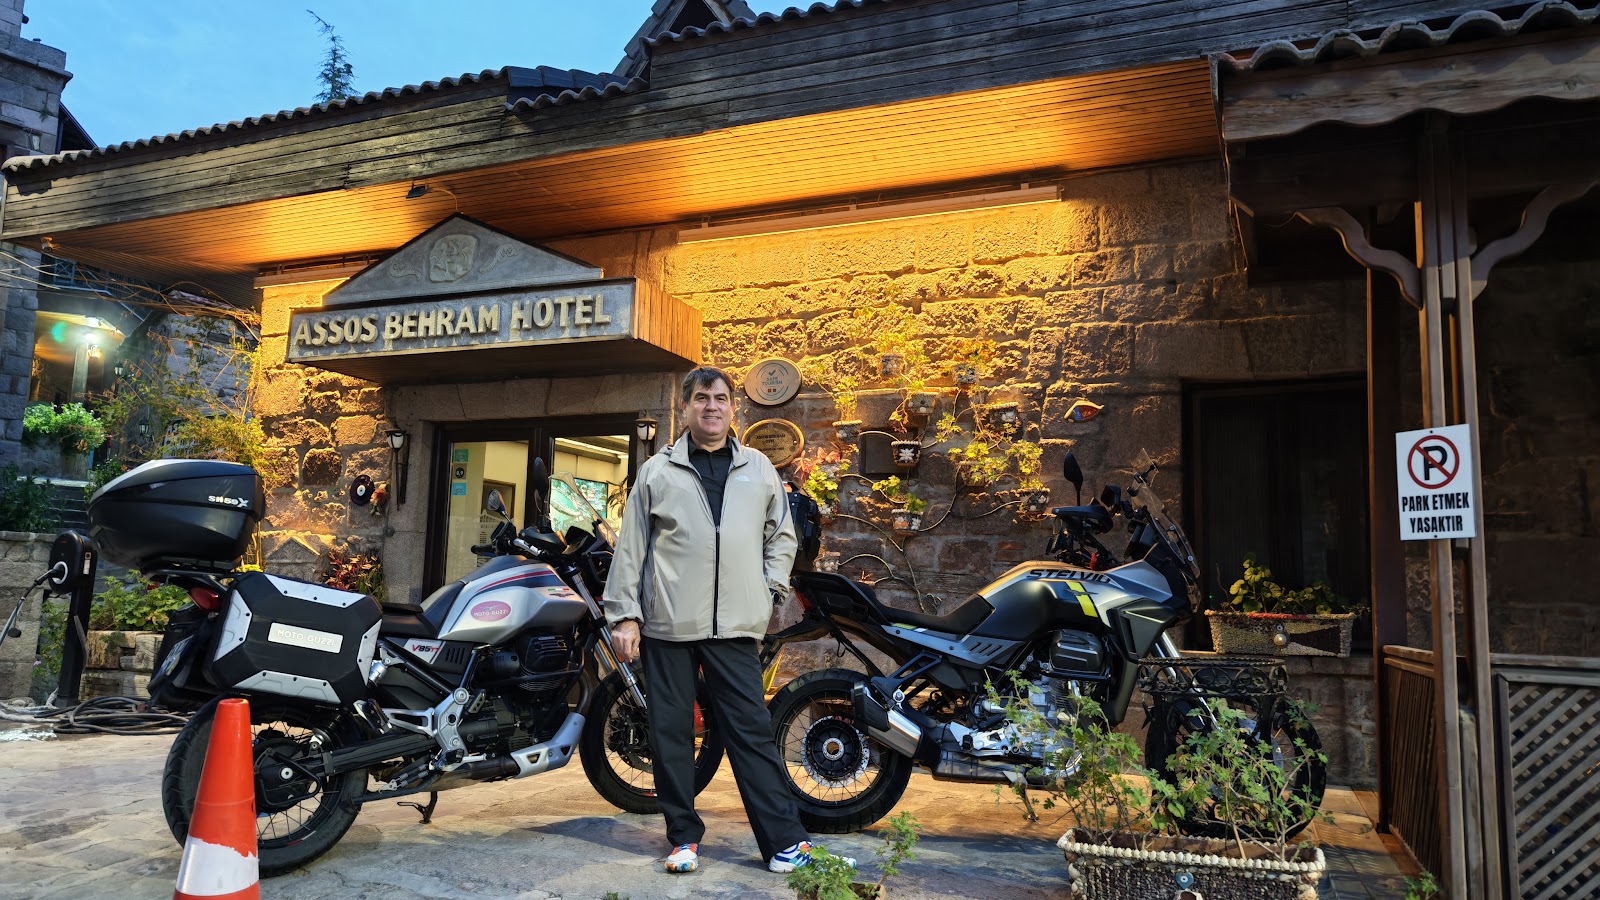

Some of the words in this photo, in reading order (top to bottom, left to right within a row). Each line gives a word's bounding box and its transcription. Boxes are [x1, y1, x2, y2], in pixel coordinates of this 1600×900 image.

[292, 313, 378, 346] ASSOS
[384, 303, 499, 340] BEHRAM
[510, 293, 612, 330] HOTEL
[1402, 495, 1430, 512] PARK
[1432, 492, 1470, 510] ETMEK
[1410, 515, 1463, 533] YASAKTIR
[277, 629, 304, 640] MOTO
[307, 635, 335, 646] GUZZI
